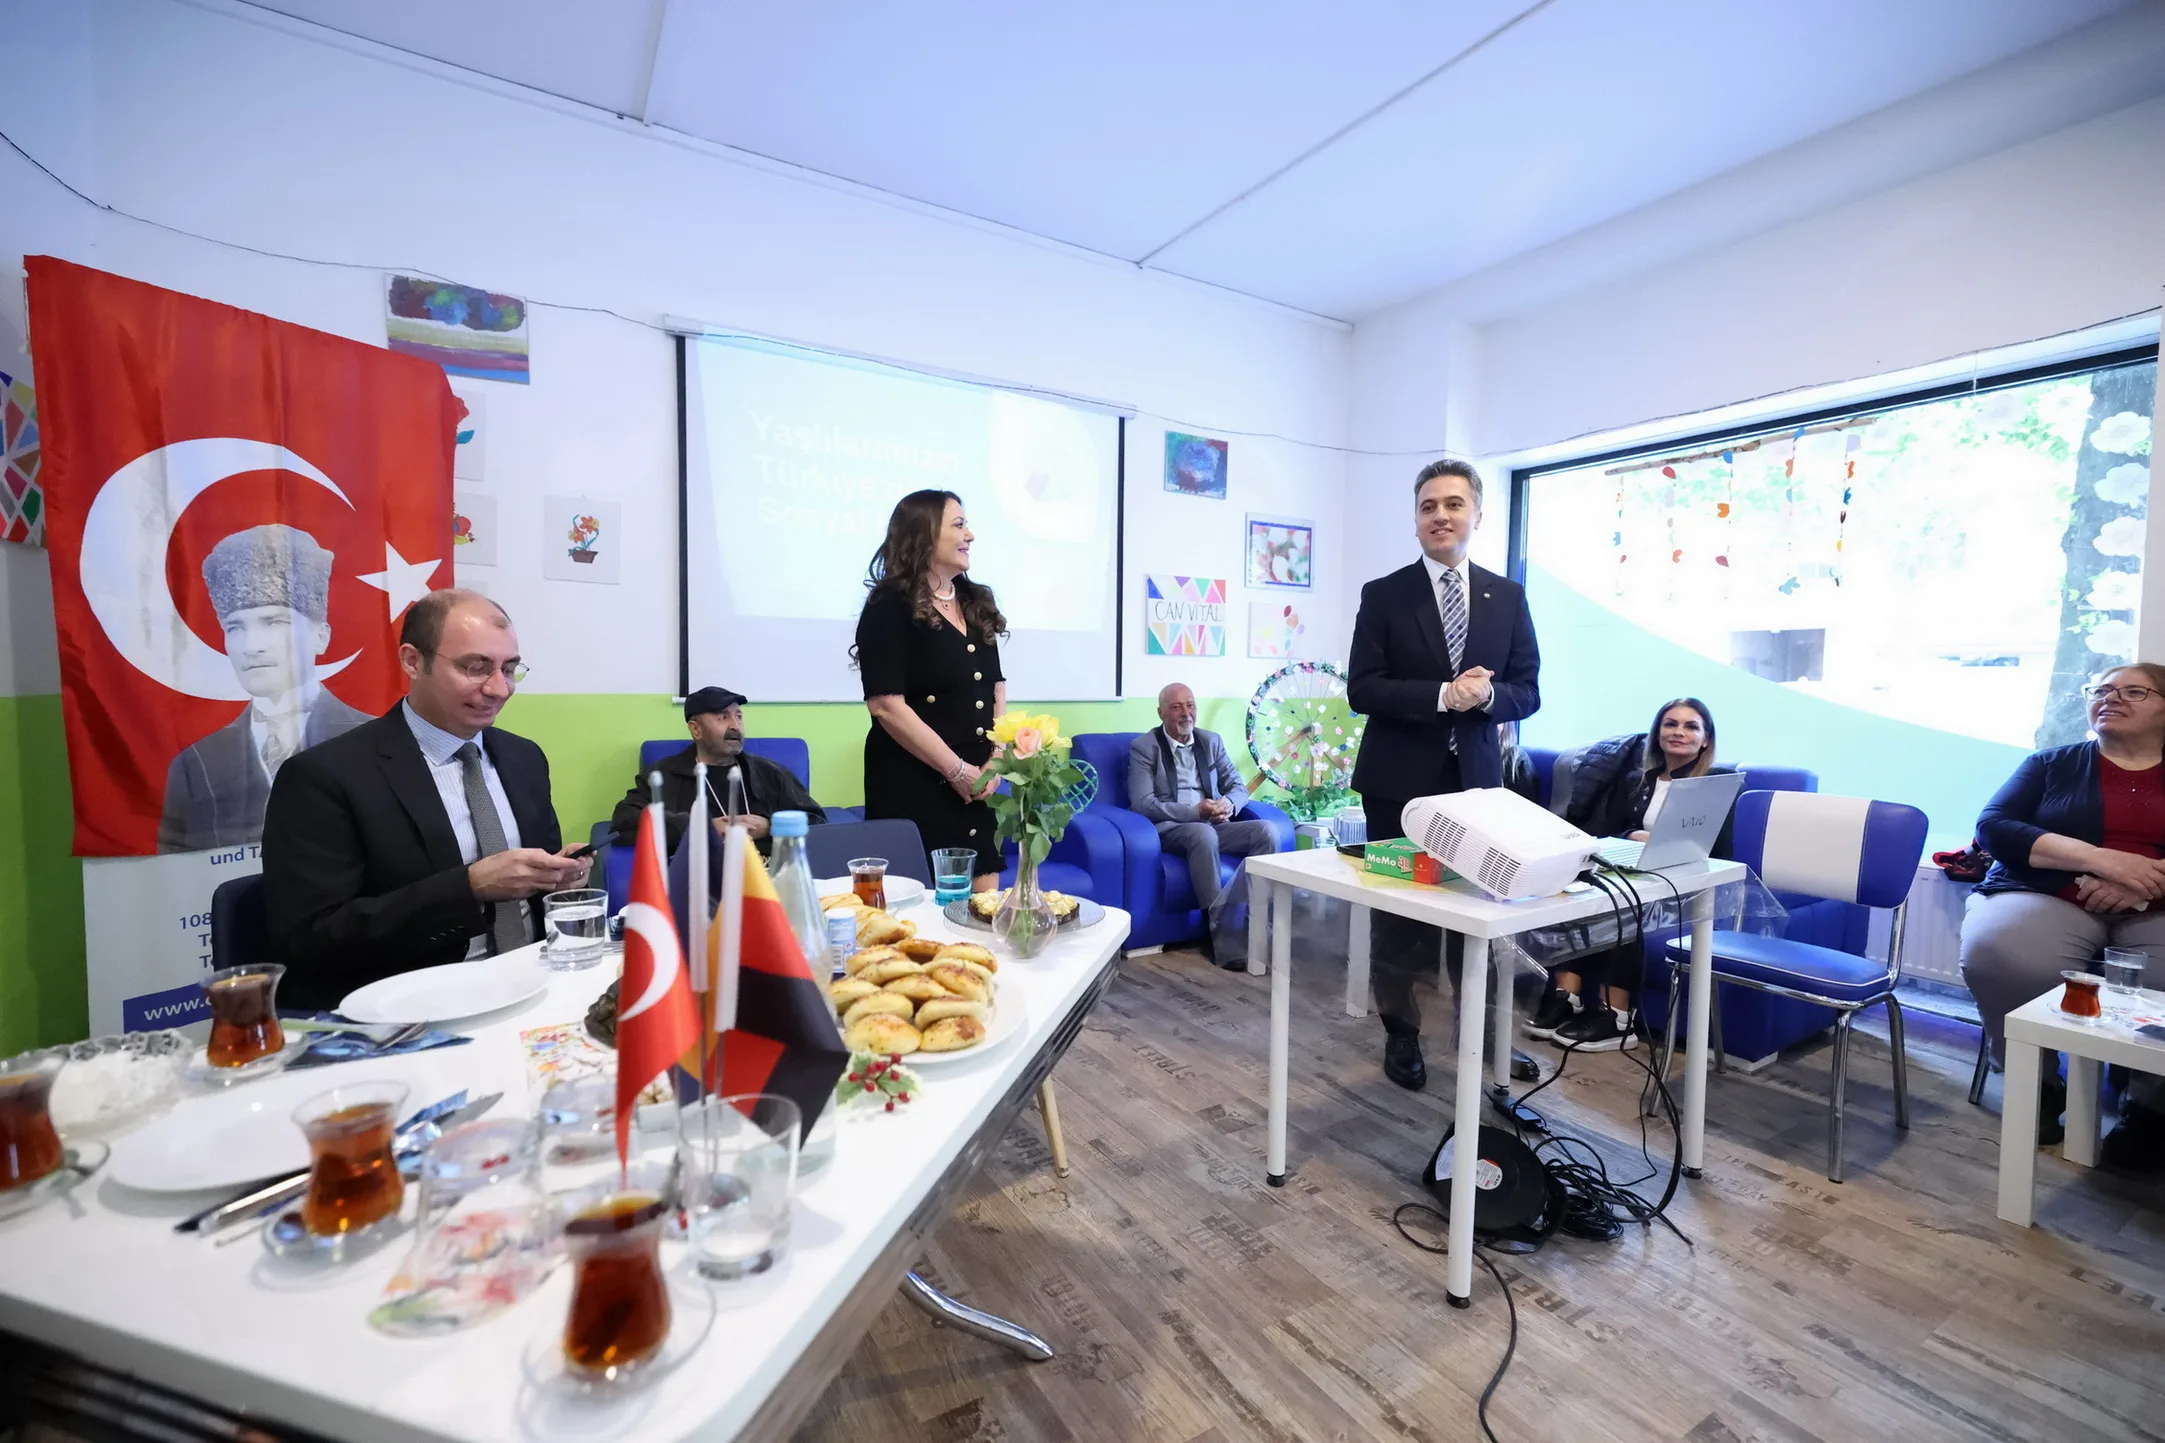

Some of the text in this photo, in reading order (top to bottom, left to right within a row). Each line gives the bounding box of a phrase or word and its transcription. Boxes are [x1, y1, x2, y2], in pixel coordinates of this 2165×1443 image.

[1155, 600, 1223, 622] CAN VITAL
[1681, 815, 1707, 829] VAIO
[210, 847, 244, 866] und
